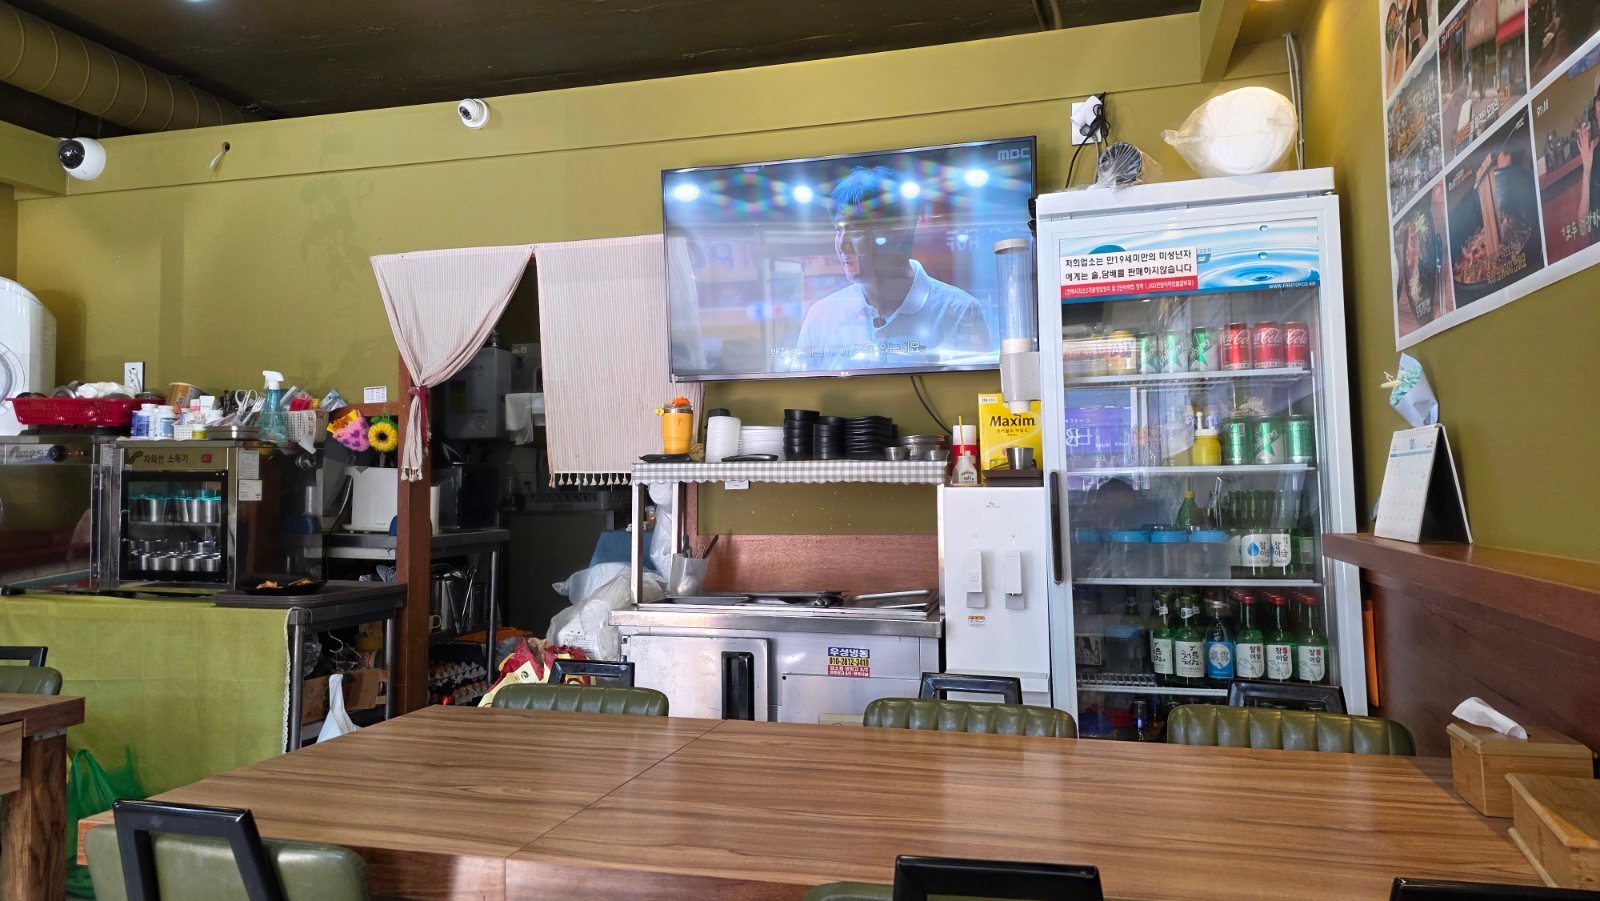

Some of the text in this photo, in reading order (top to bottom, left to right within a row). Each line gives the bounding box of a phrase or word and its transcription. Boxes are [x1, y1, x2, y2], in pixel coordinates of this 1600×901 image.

[1065, 256, 1104, 268] 저희업소는
[1106, 252, 1156, 265] 만19세미만의
[1159, 249, 1192, 261] 미성년자
[1065, 271, 1089, 282] 에게는
[1127, 263, 1192, 277] 판매하지않습니다
[990, 414, 1035, 427] Maxim
[143, 452, 189, 464] 자외선 소독기
[829, 647, 869, 658] 우성냉동
